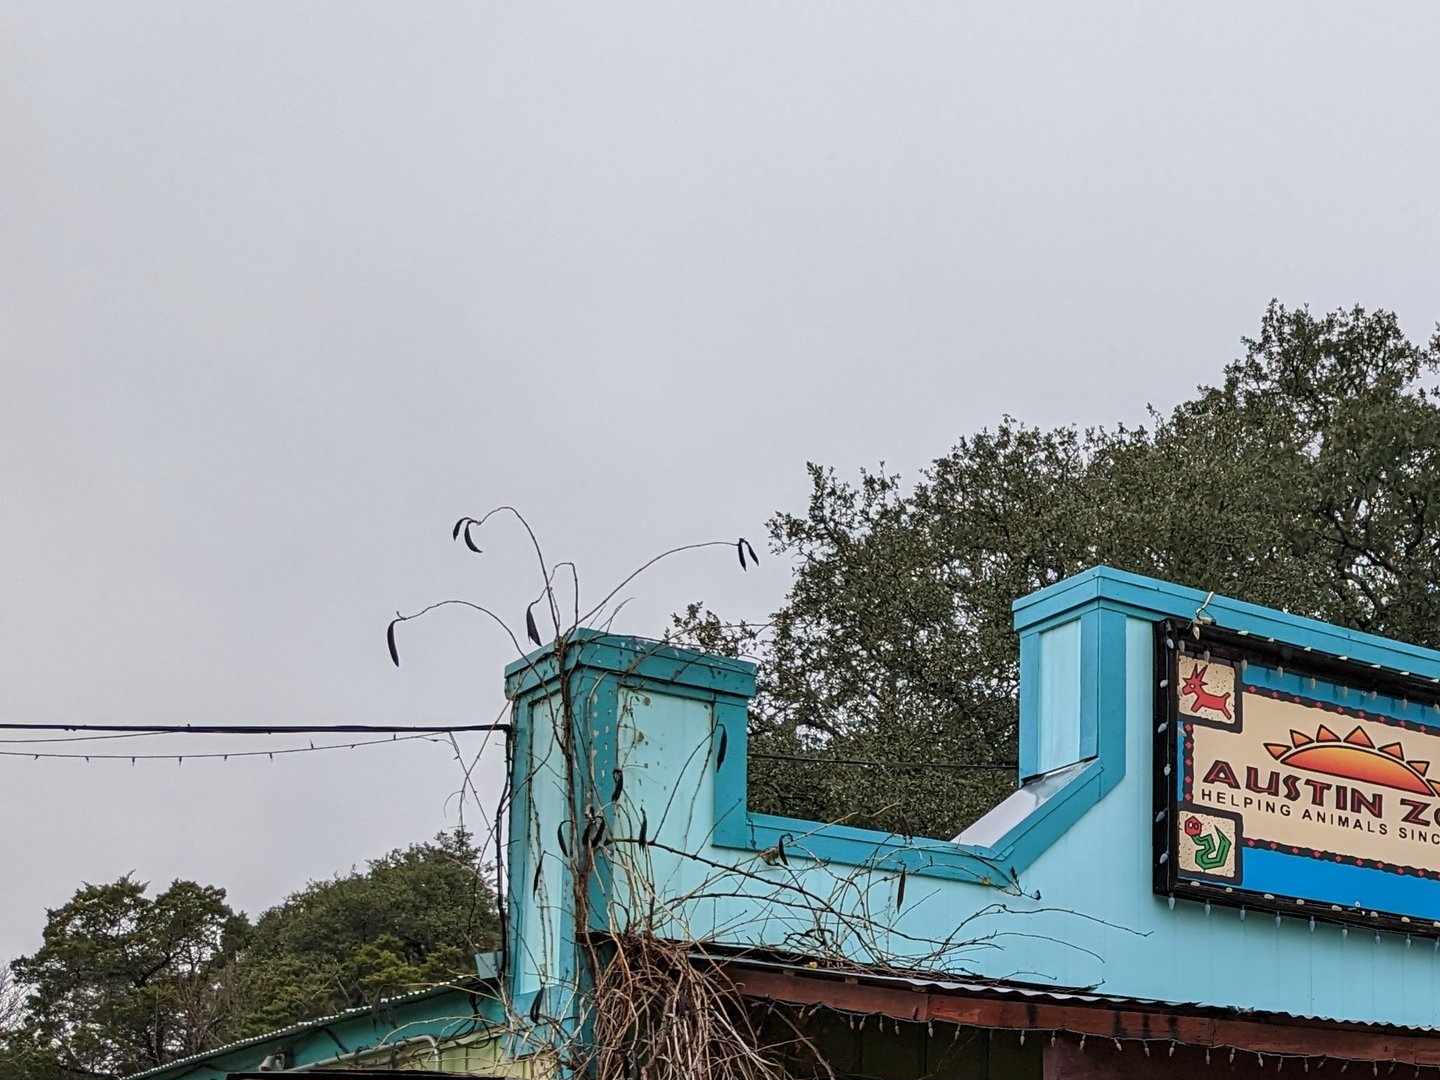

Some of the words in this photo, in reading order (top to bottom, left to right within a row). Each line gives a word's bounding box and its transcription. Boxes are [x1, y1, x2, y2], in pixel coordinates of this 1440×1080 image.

[1201, 789, 1291, 816] HELPING
[1302, 809, 1388, 835] ANIMALS
[1203, 760, 1383, 818] AUSTIN
